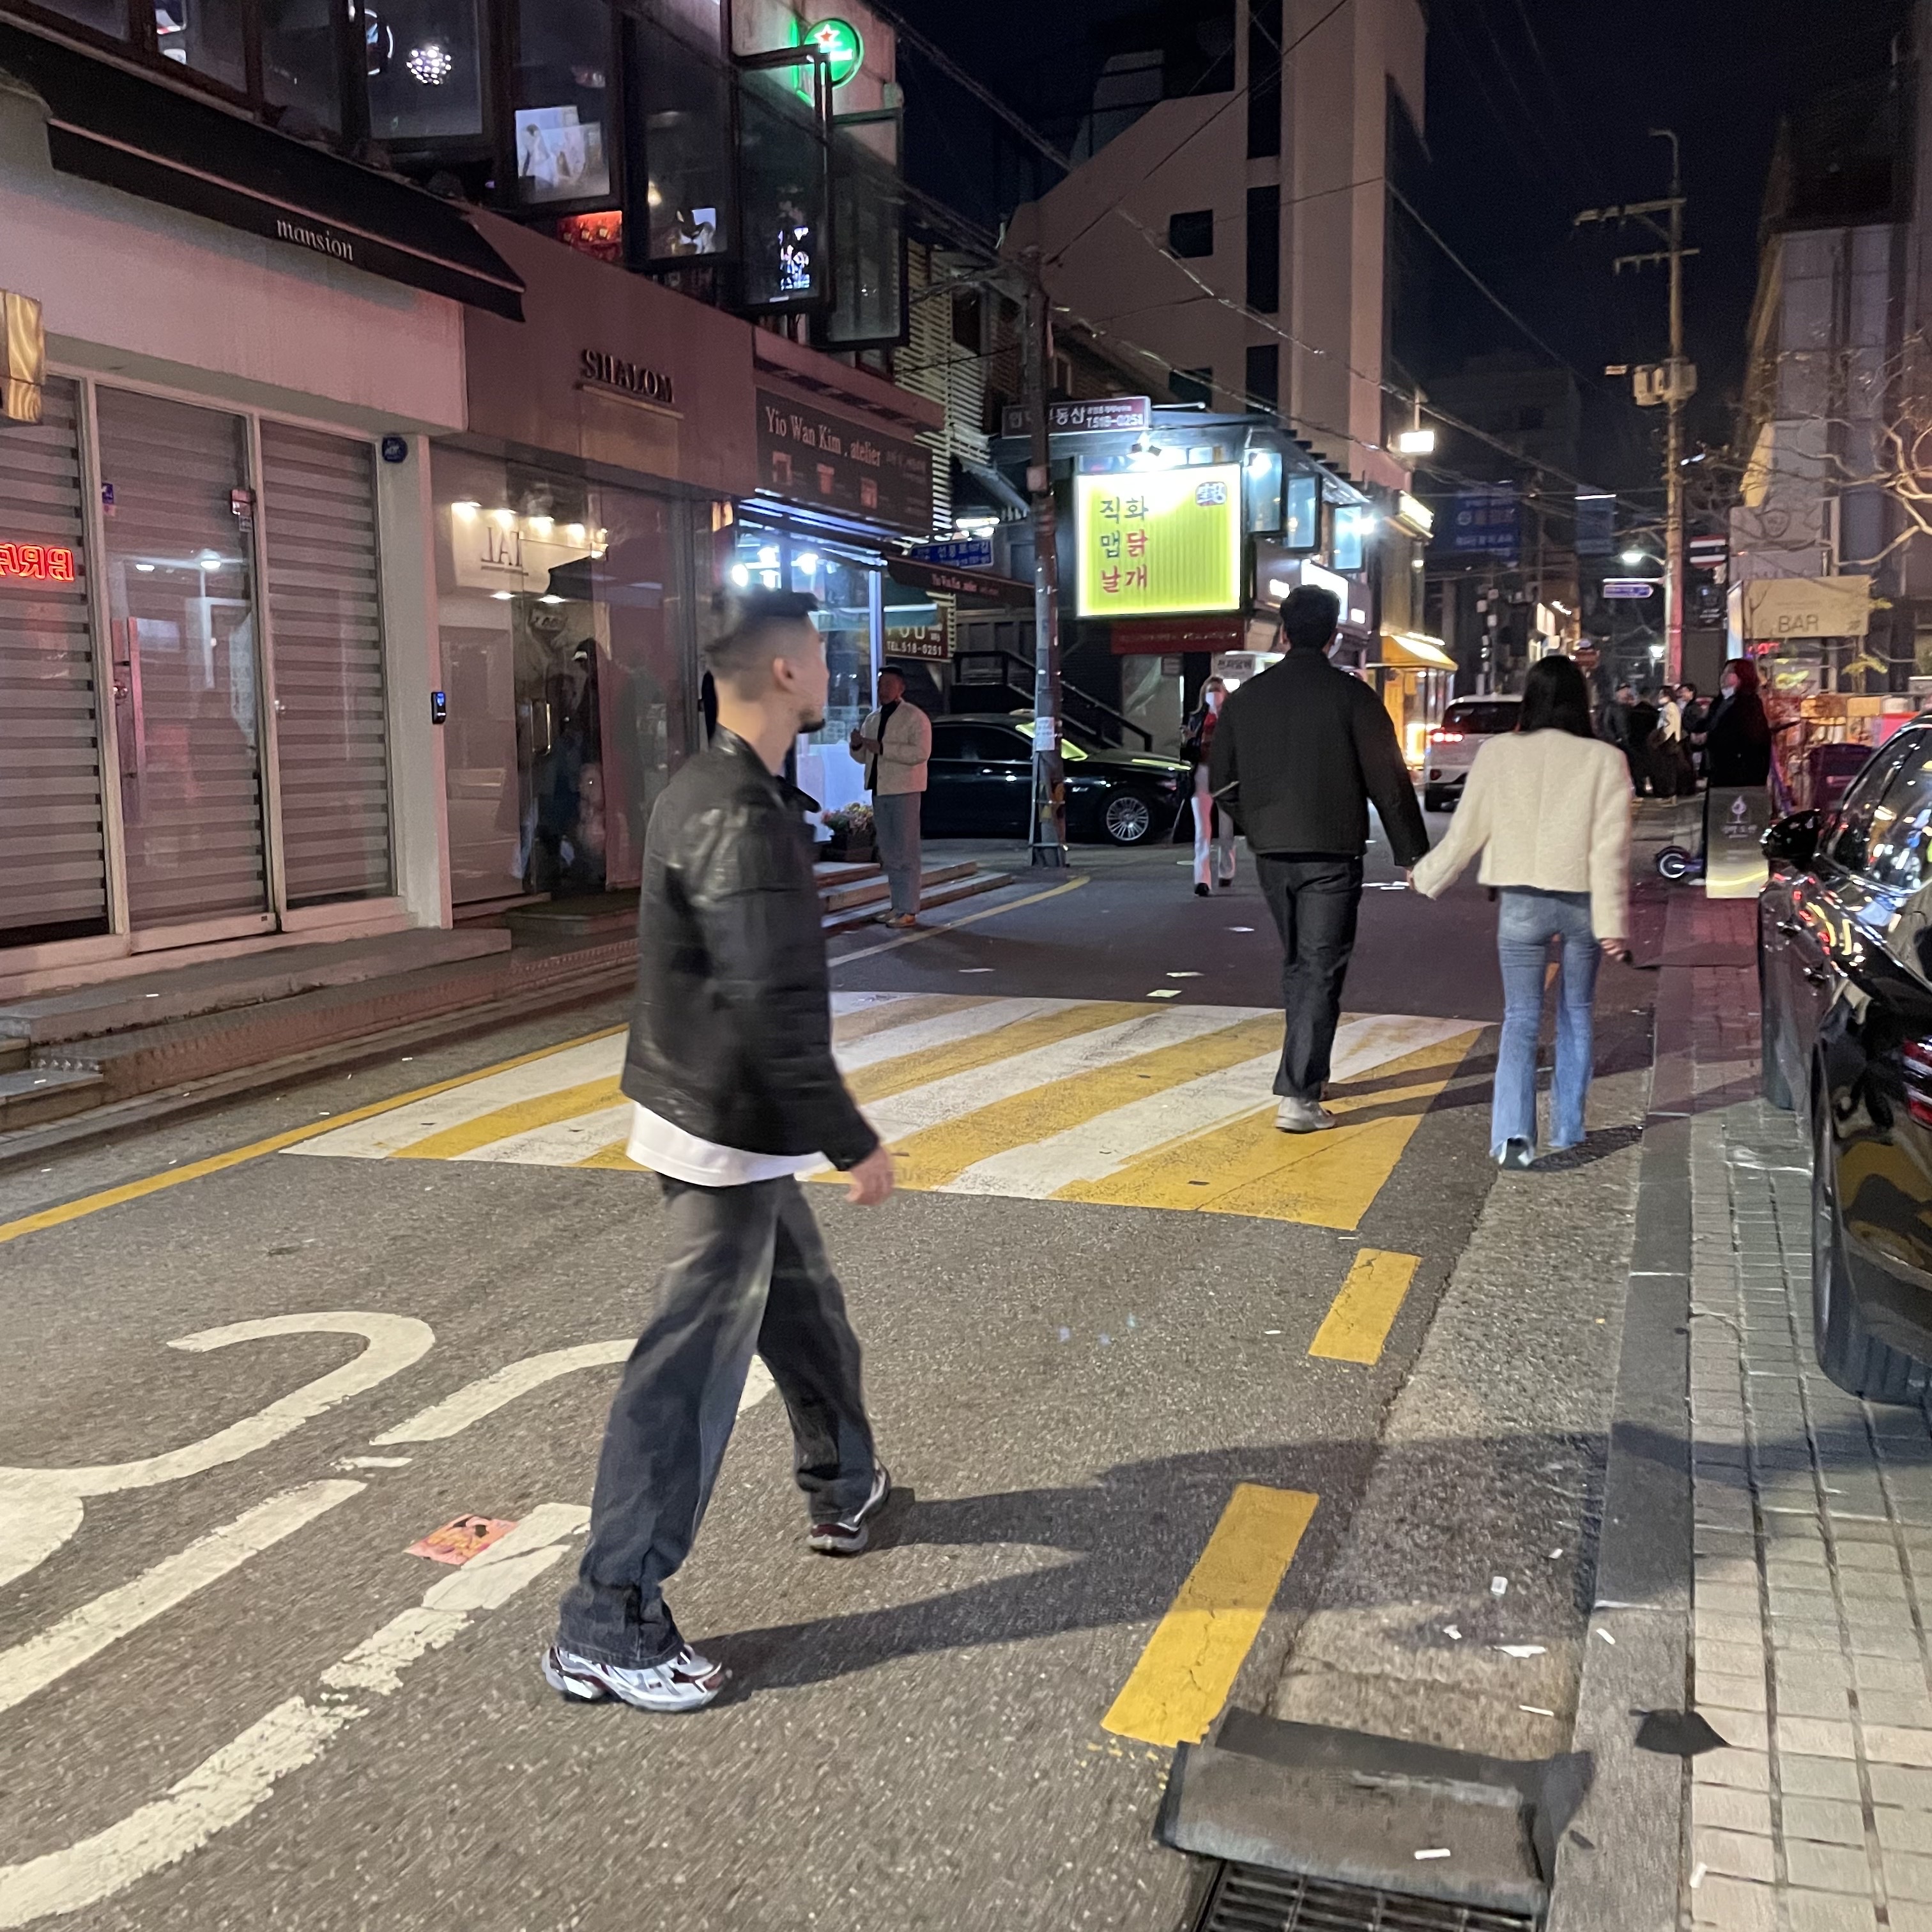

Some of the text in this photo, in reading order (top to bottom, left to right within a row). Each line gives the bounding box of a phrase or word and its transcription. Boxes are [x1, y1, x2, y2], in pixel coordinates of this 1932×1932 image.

[277, 218, 354, 261] mansion
[766, 406, 787, 437] Yio
[790, 414, 815, 447] Wan
[818, 424, 841, 455] Kim
[850, 440, 881, 468] atelier
[1099, 495, 1149, 524] 직화
[1100, 529, 1149, 559] 맵닭
[1100, 564, 1148, 594] 날개
[1778, 615, 1819, 632] BAR
